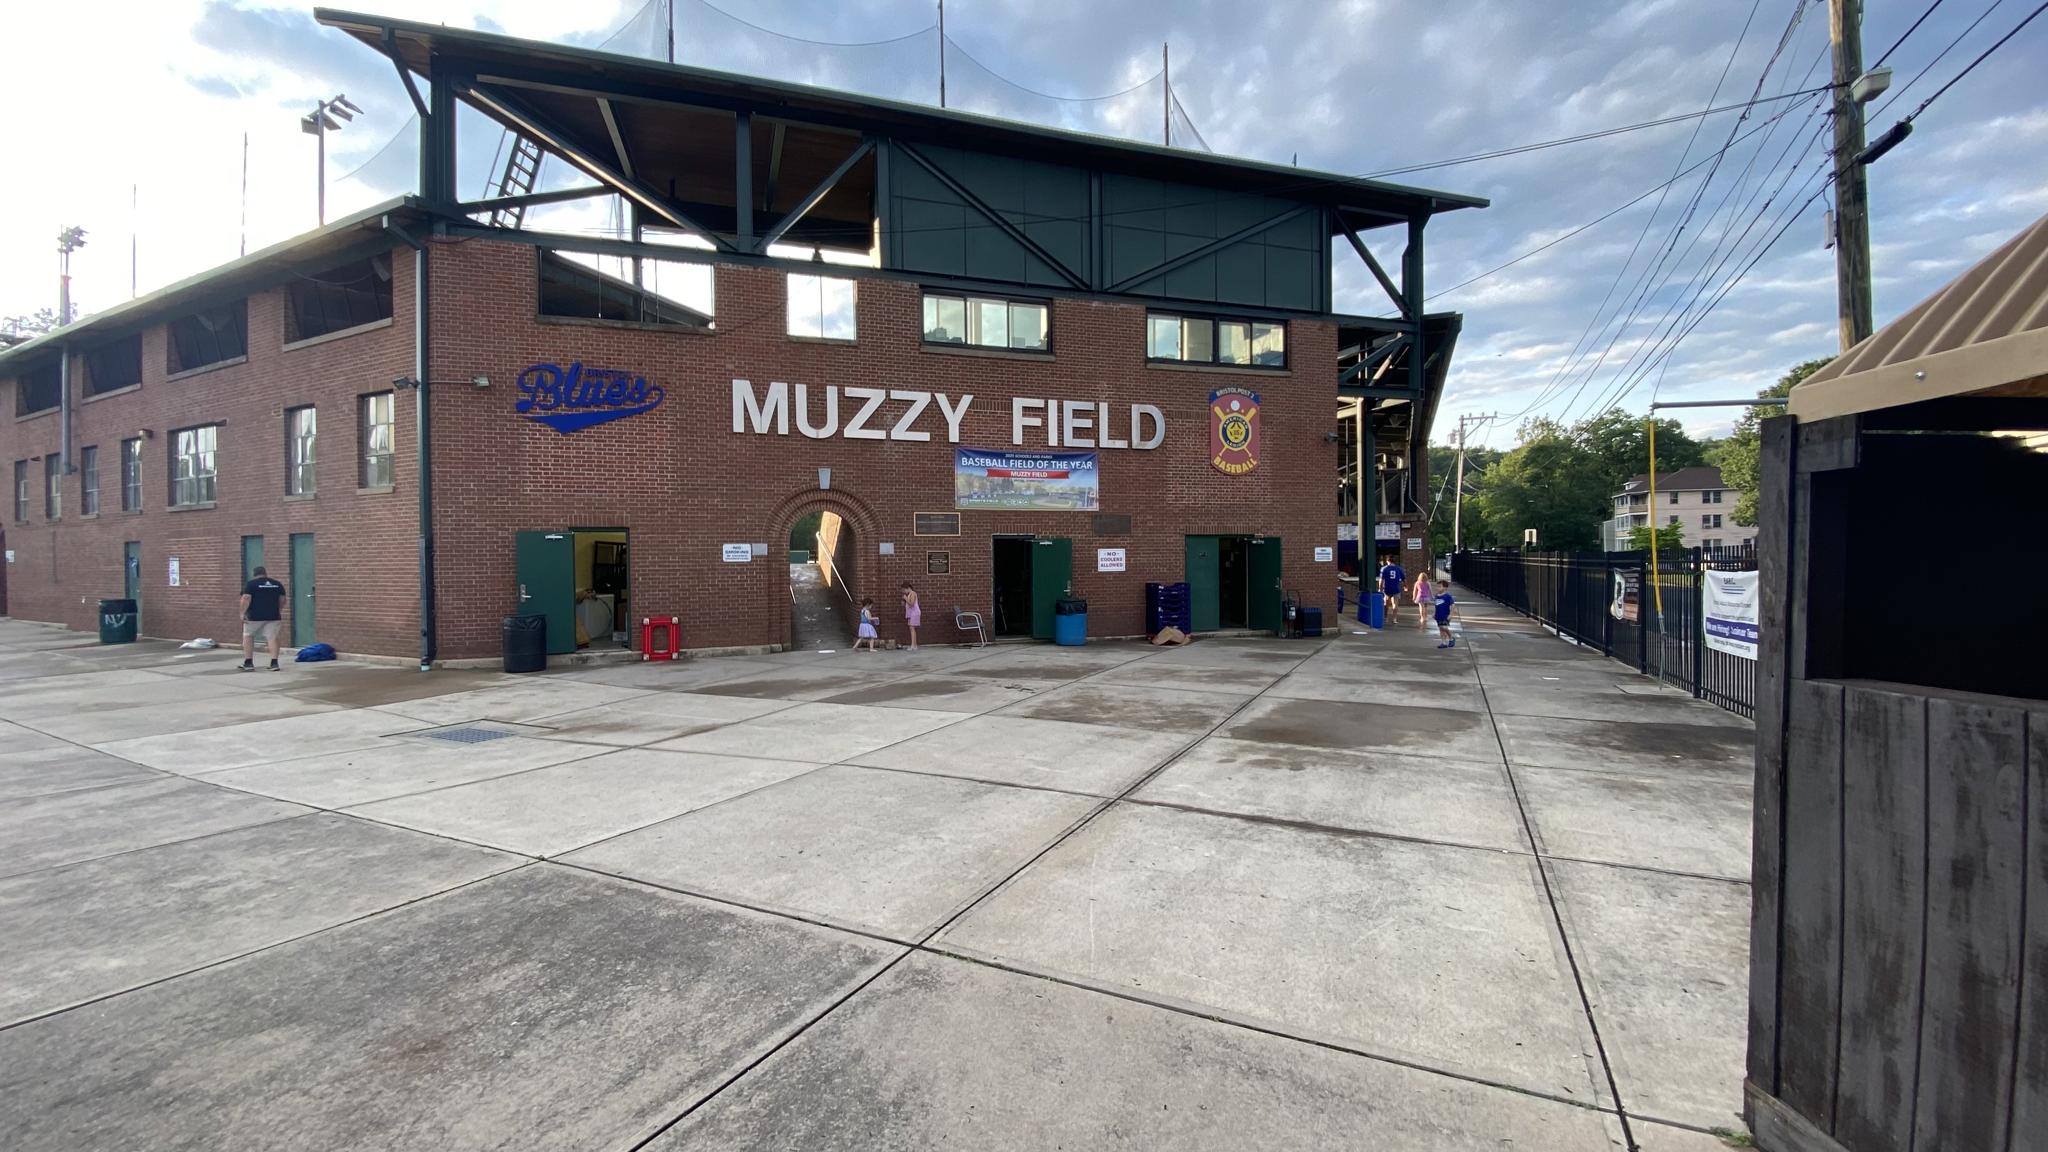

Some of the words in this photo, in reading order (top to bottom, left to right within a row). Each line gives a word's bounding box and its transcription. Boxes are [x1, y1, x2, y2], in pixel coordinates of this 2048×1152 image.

[515, 359, 649, 412] Blues
[1216, 387, 1237, 397] BRISTOL
[1238, 387, 1251, 397] POST
[732, 379, 974, 443] MUZZY
[1011, 396, 1166, 450] FIELD
[961, 457, 1008, 468] BASEBALL
[1010, 460, 1035, 469] FIELD
[1036, 460, 1049, 469] OF
[1050, 460, 1069, 470] THE
[1070, 461, 1093, 470] YEAR
[1213, 456, 1257, 473] BASEBALL
[1010, 470, 1032, 478] MUZZY
[1390, 570, 1397, 580] 9
